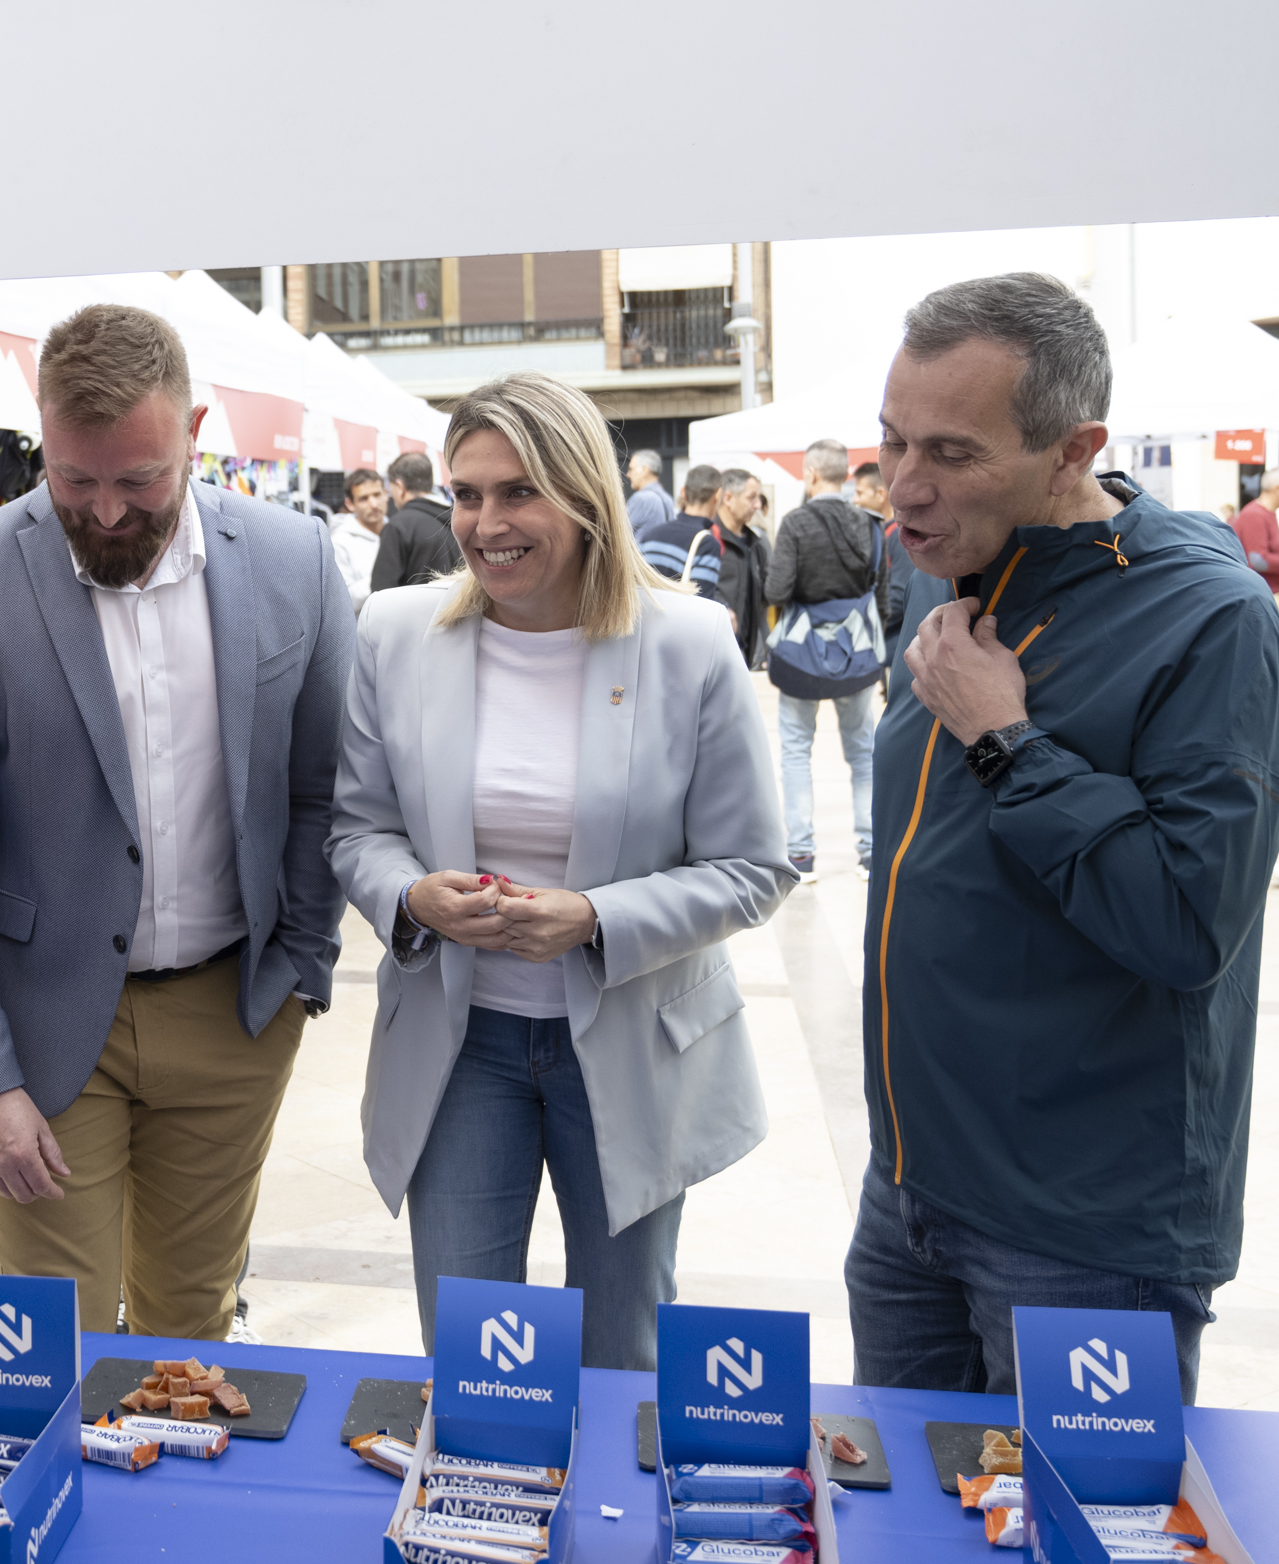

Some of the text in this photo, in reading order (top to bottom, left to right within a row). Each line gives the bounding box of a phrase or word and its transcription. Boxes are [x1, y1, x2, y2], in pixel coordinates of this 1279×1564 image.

[458, 1378, 553, 1403] nutrinovex
[685, 1403, 784, 1426] nutrinovex
[1052, 1412, 1156, 1433] nutrinovex
[38, 1470, 74, 1545] nutrinovex
[442, 1498, 542, 1526] Nutrinovex
[1081, 1506, 1162, 1517] Glucobar
[701, 1543, 782, 1558] Glucobar
